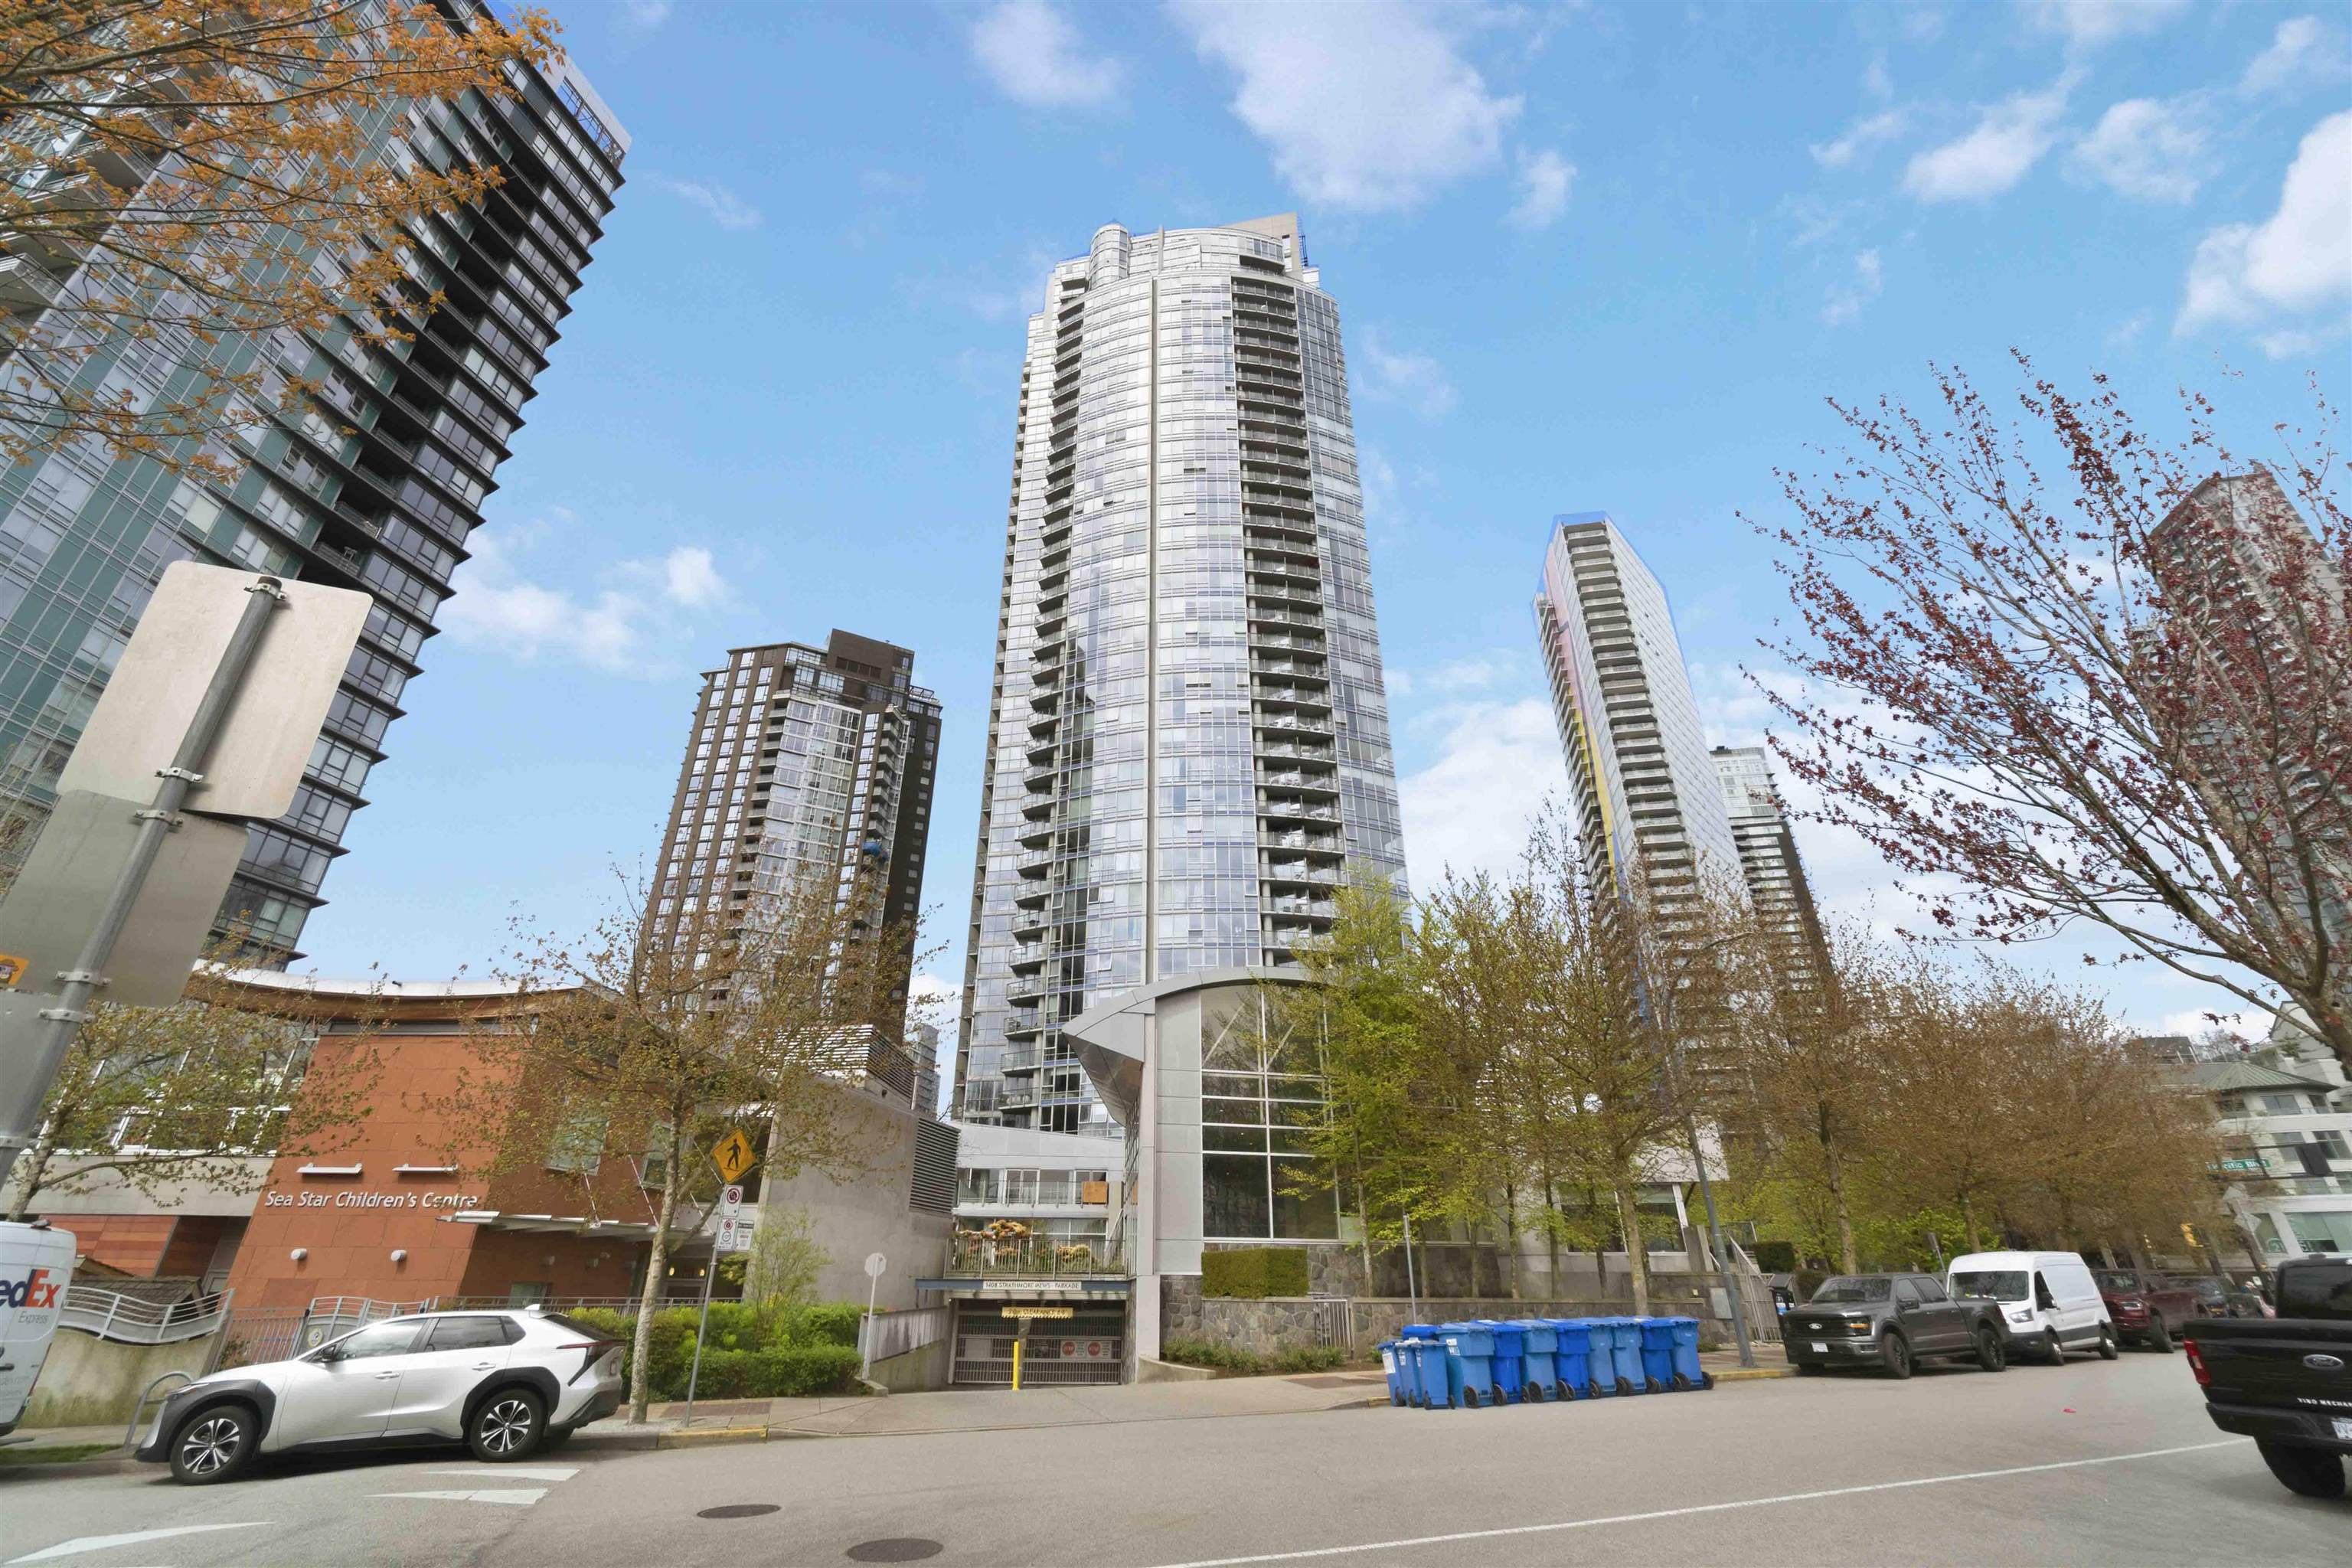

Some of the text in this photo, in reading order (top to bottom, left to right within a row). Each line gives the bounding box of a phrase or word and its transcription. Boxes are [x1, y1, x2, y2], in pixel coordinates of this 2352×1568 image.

[264, 1191, 293, 1207] Sea
[298, 1191, 332, 1207] Star
[335, 1191, 417, 1208] Children's
[0, 1269, 61, 1308] edEx
